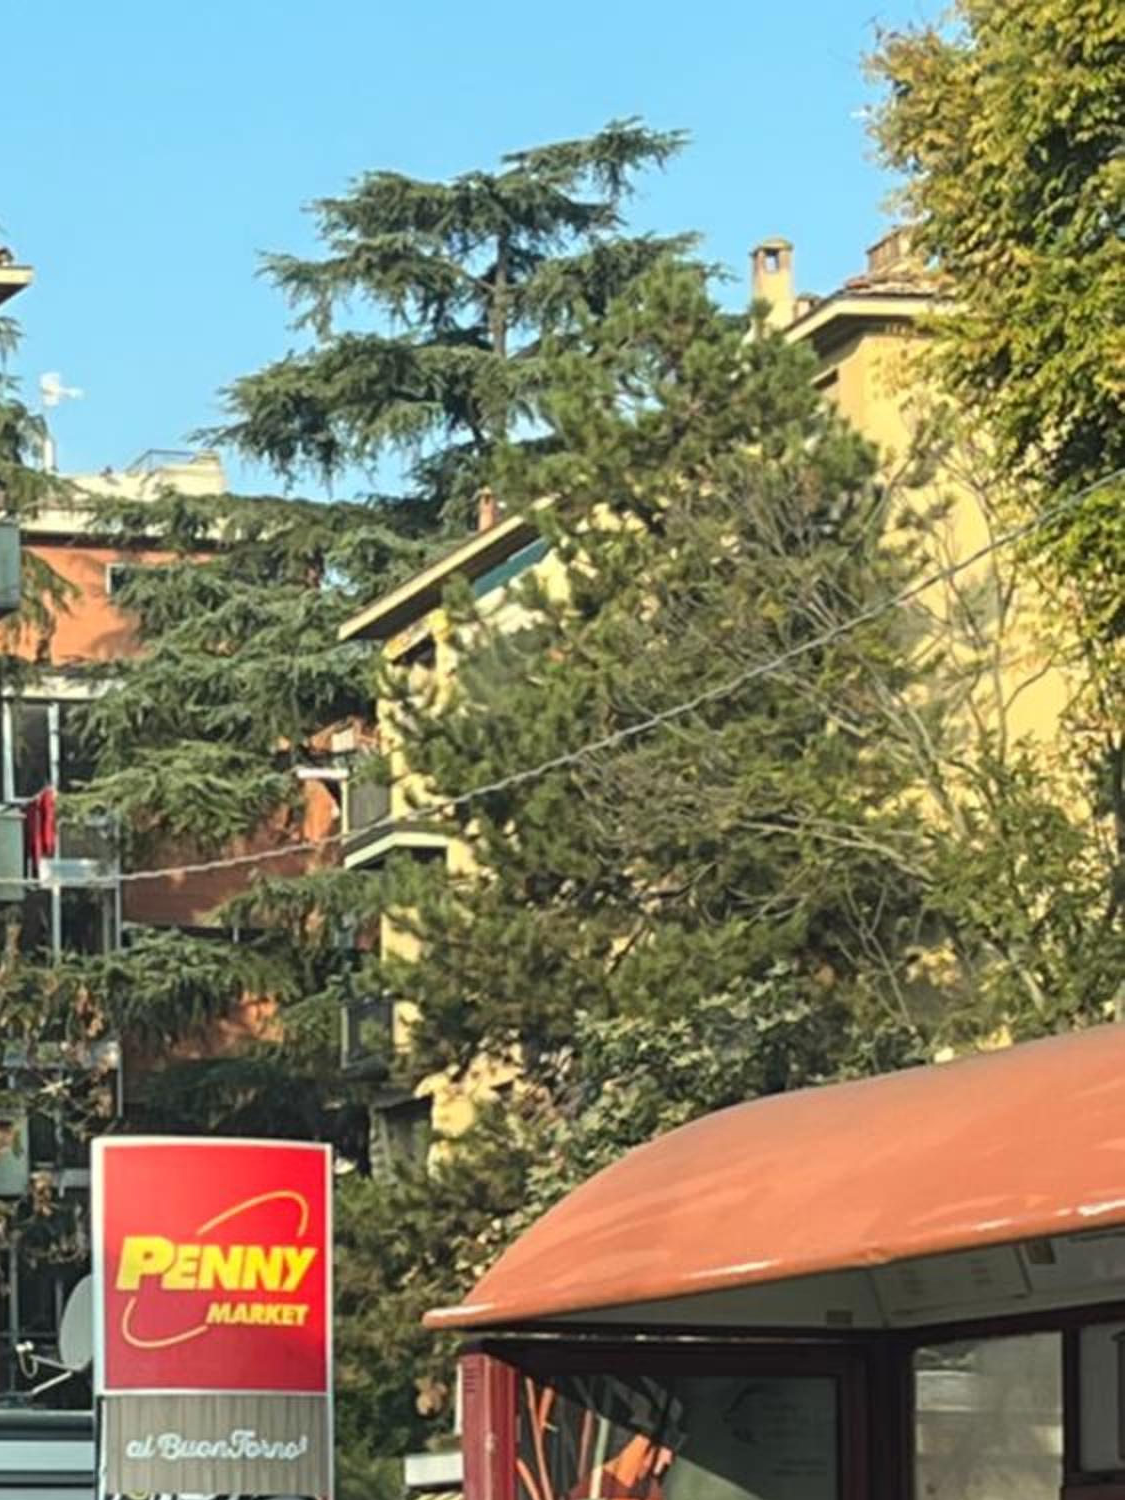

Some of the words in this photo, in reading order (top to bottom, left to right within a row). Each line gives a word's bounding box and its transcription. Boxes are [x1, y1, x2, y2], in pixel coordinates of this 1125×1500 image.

[115, 1235, 318, 1291] PENNY
[205, 1302, 310, 1326] MARKET
[126, 1434, 156, 1459] al
